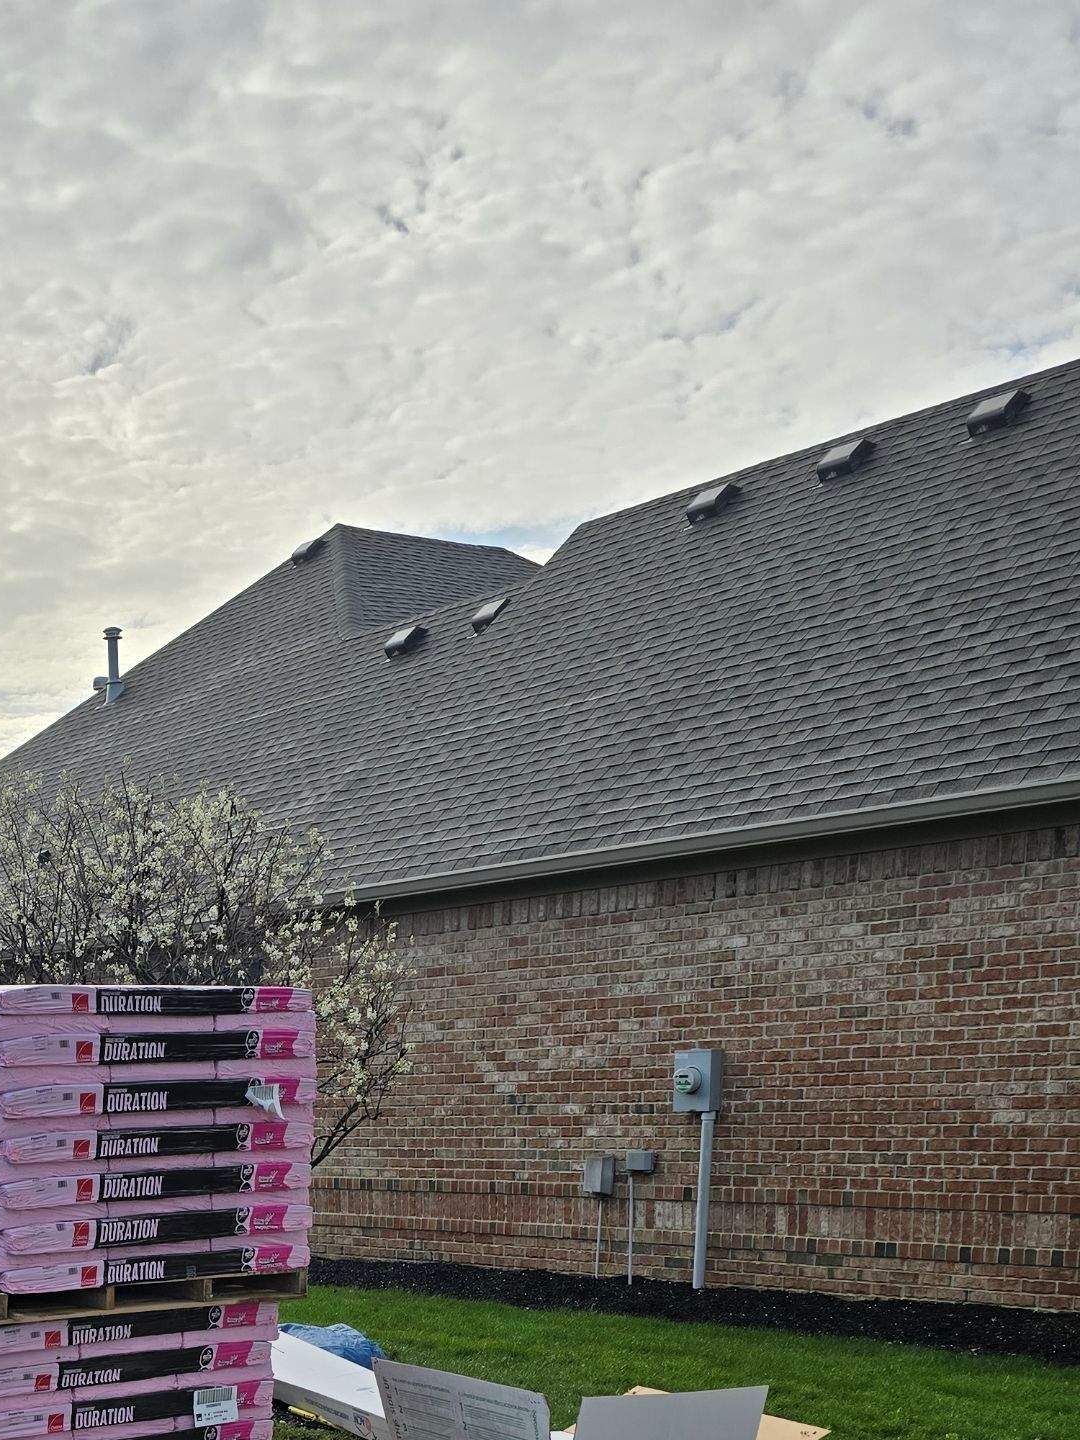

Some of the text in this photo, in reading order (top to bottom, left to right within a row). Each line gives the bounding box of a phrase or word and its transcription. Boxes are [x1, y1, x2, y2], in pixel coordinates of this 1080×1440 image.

[101, 995, 162, 1013] DURATION
[104, 1041, 166, 1061] DURATION
[107, 1091, 167, 1112] DURATION
[100, 1137, 159, 1157] DURATION
[103, 1176, 162, 1199] DURATION
[100, 1219, 159, 1242] DURATION
[108, 1260, 165, 1283] DURATION
[72, 1324, 132, 1346] DURATION
[61, 1368, 121, 1388] DURATION
[75, 1406, 134, 1429] DURATION
